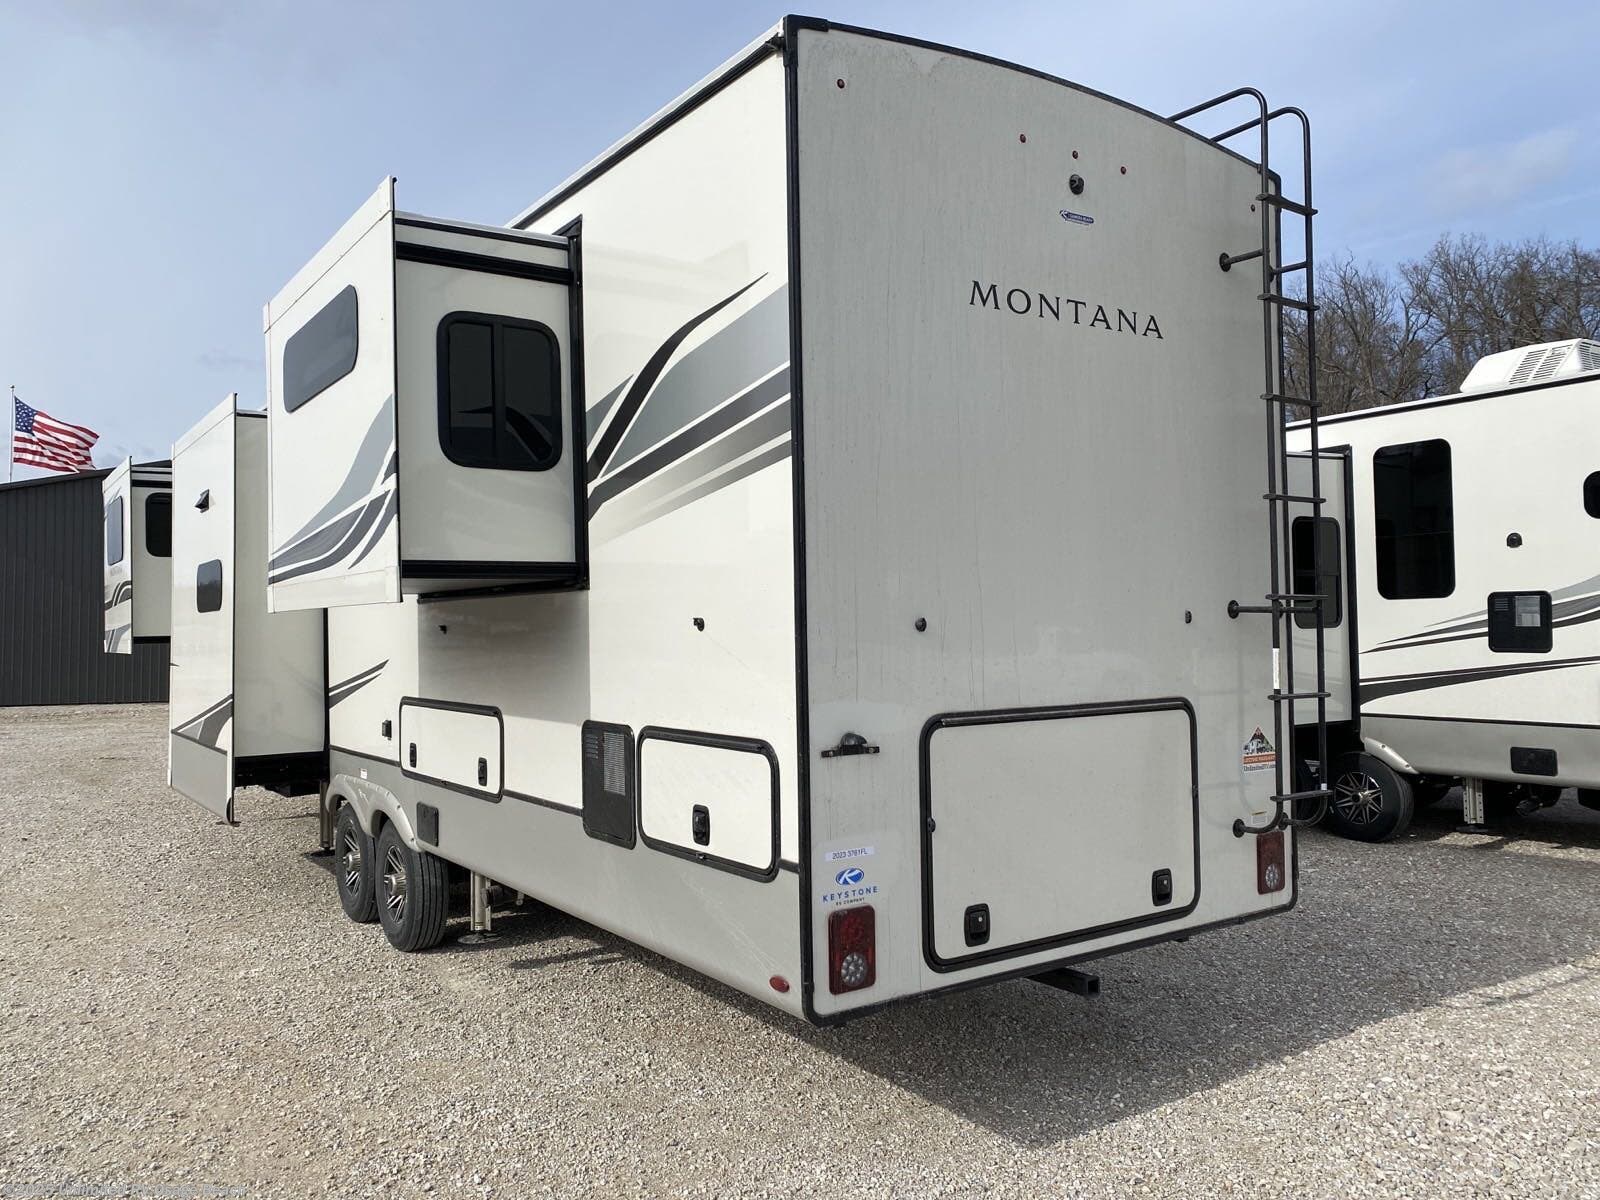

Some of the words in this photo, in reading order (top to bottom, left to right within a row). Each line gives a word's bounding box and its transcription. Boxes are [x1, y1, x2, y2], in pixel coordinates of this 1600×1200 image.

[969, 280, 1164, 339] MONTANA
[832, 851, 847, 859] 2023
[822, 886, 878, 903] KEYSTONE
